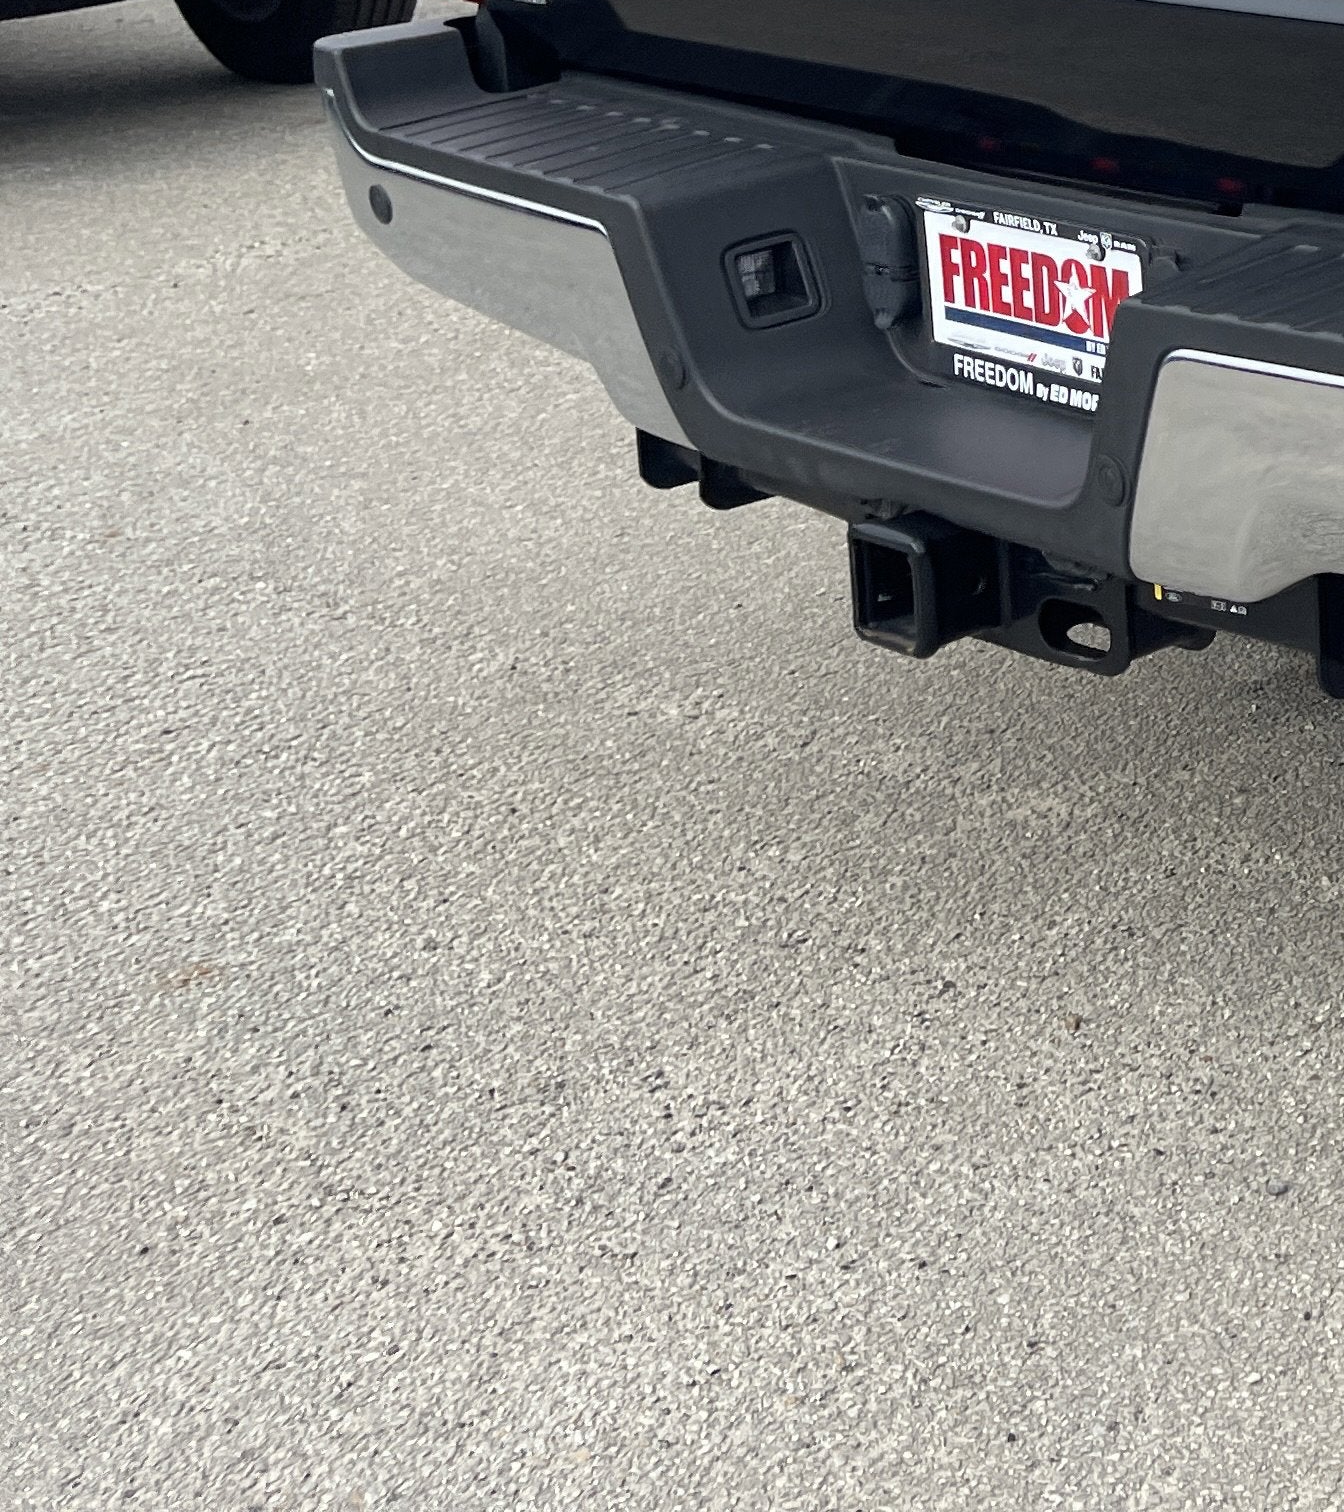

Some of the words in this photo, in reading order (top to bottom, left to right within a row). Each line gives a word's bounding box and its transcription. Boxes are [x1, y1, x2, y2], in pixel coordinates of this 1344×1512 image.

[993, 211, 1043, 235] FAIRFIELD,
[1043, 221, 1058, 236] TX
[938, 233, 1129, 338] FREEDOM
[953, 353, 1034, 396] FREEDOM
[1050, 383, 1068, 404] ED
[1070, 388, 1099, 412] MOR
